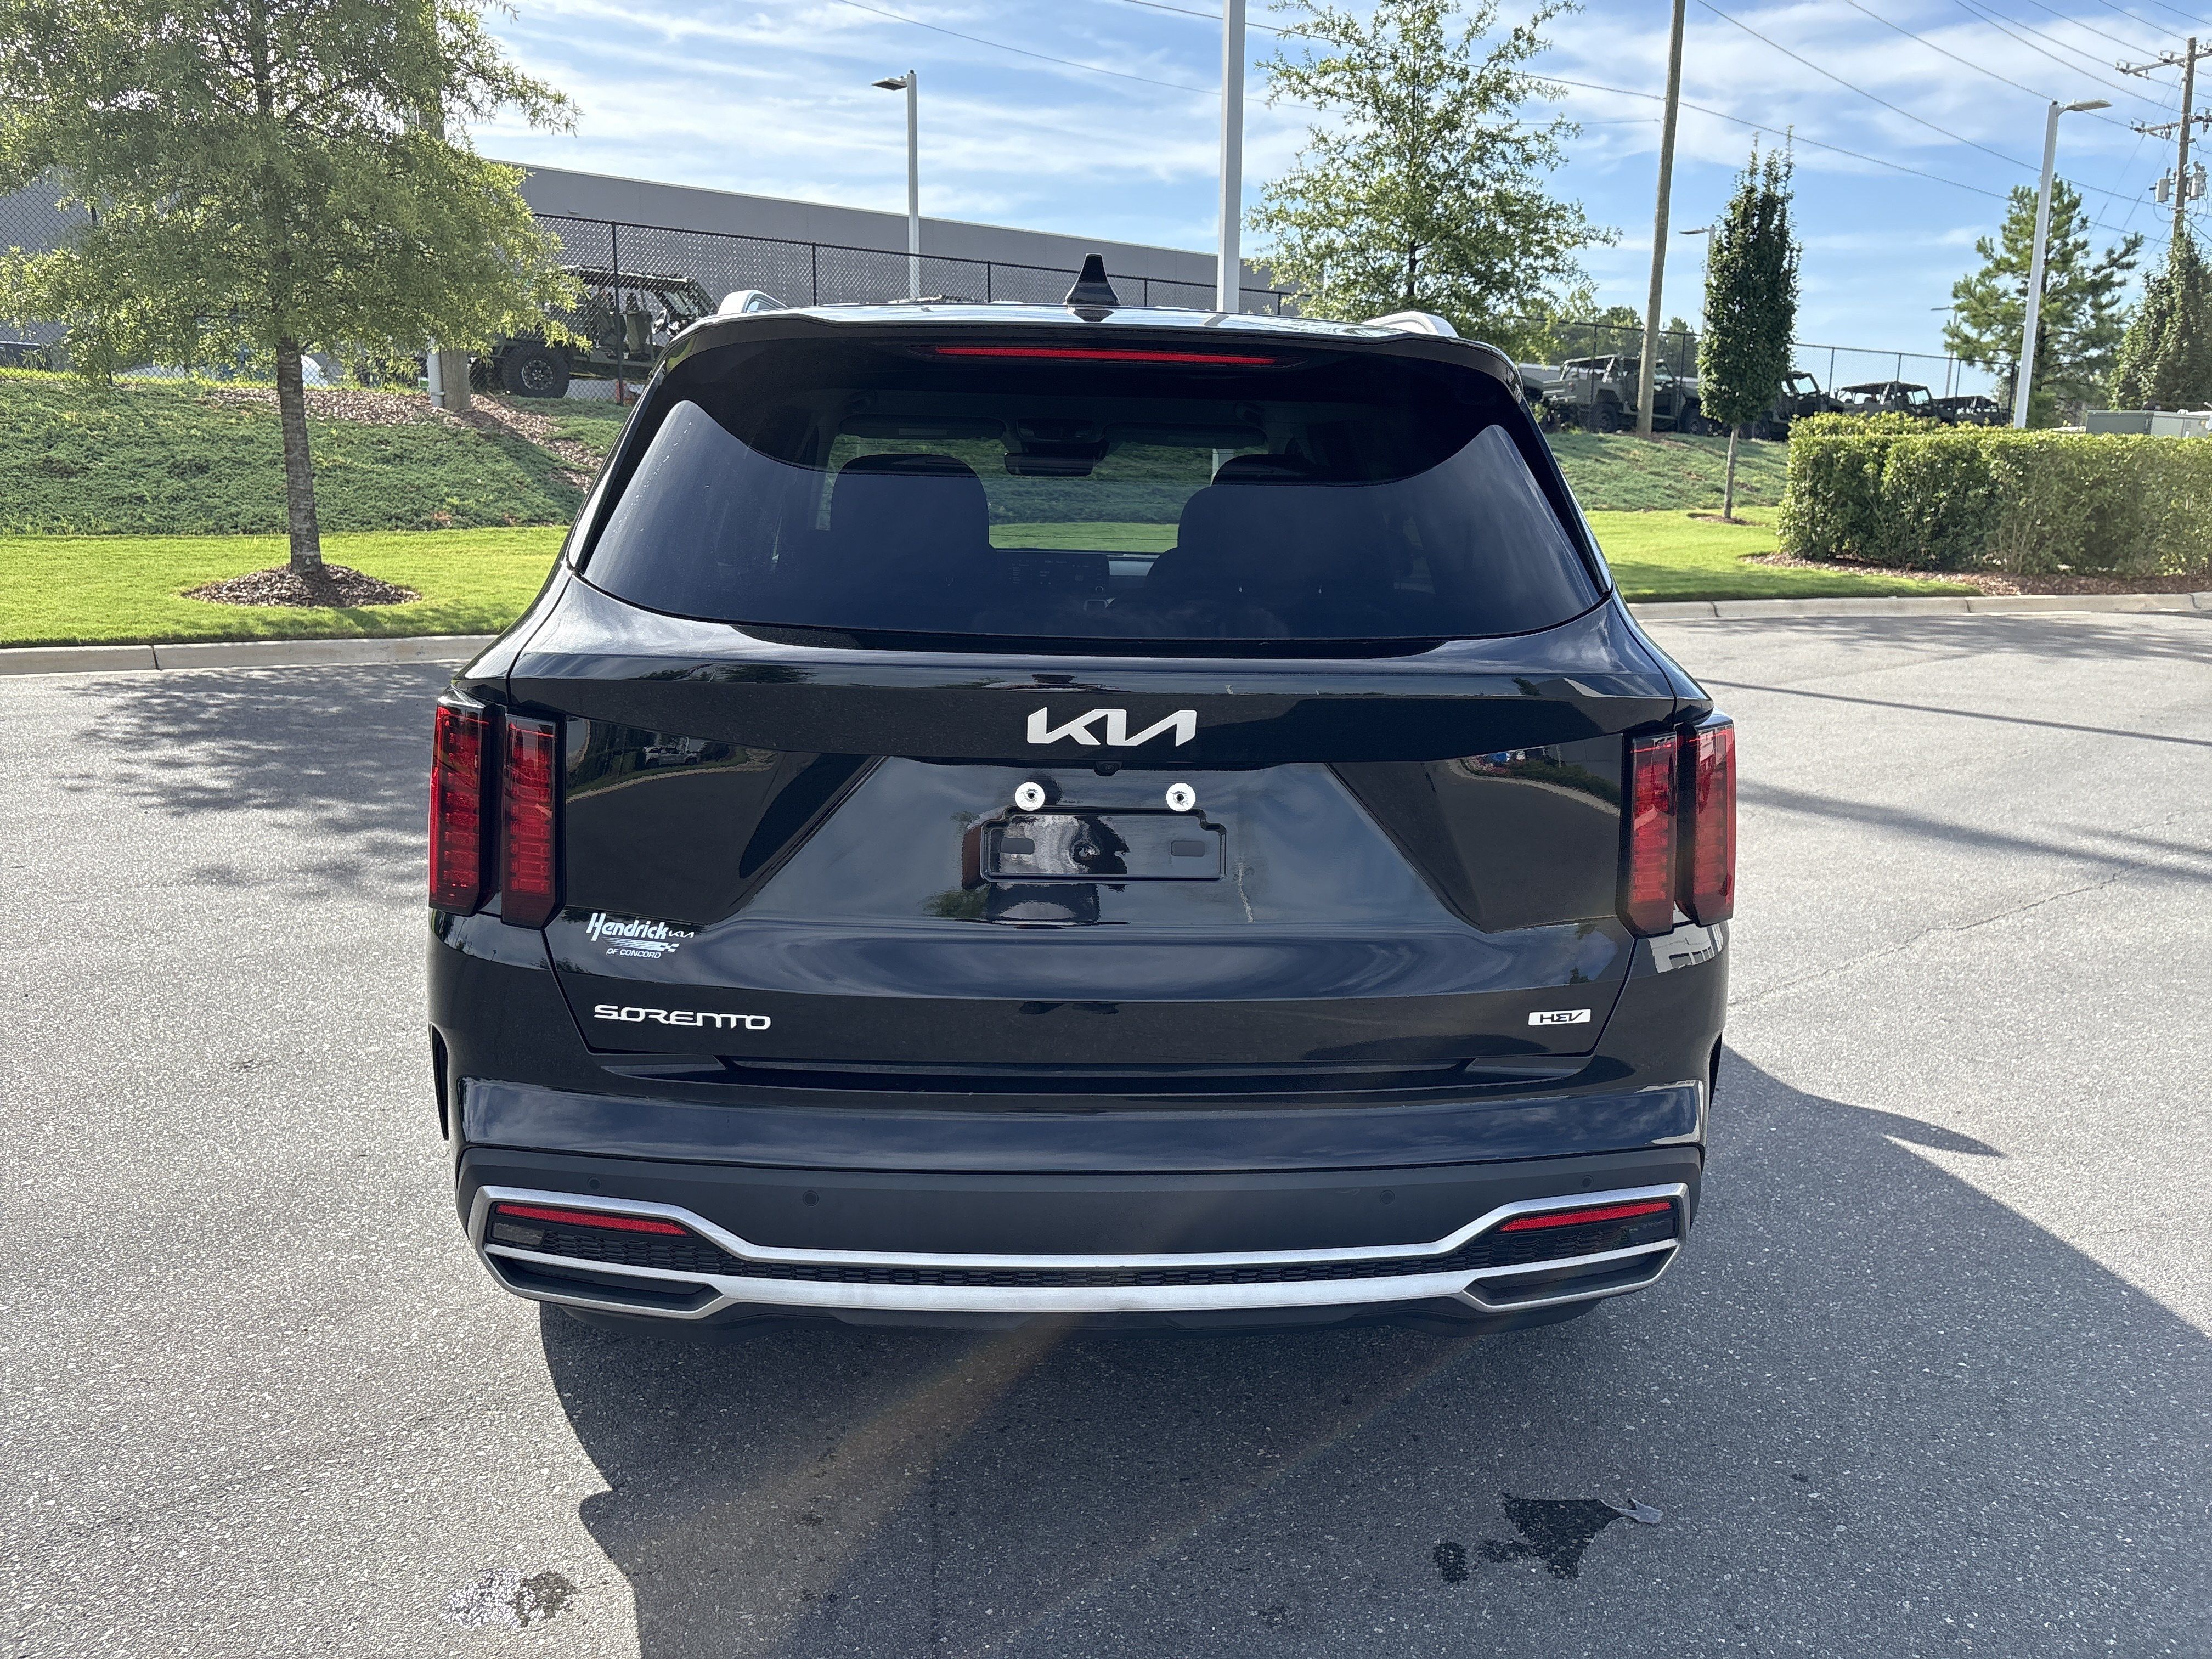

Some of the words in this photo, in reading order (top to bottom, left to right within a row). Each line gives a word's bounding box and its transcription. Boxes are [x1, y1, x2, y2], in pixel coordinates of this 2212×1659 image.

[1027, 707, 1197, 747] KIA
[586, 912, 670, 941] Hendrick
[619, 949, 662, 958] CONCORD
[594, 1005, 771, 1030] SORENTO
[1540, 1012, 1584, 1023] HEV
